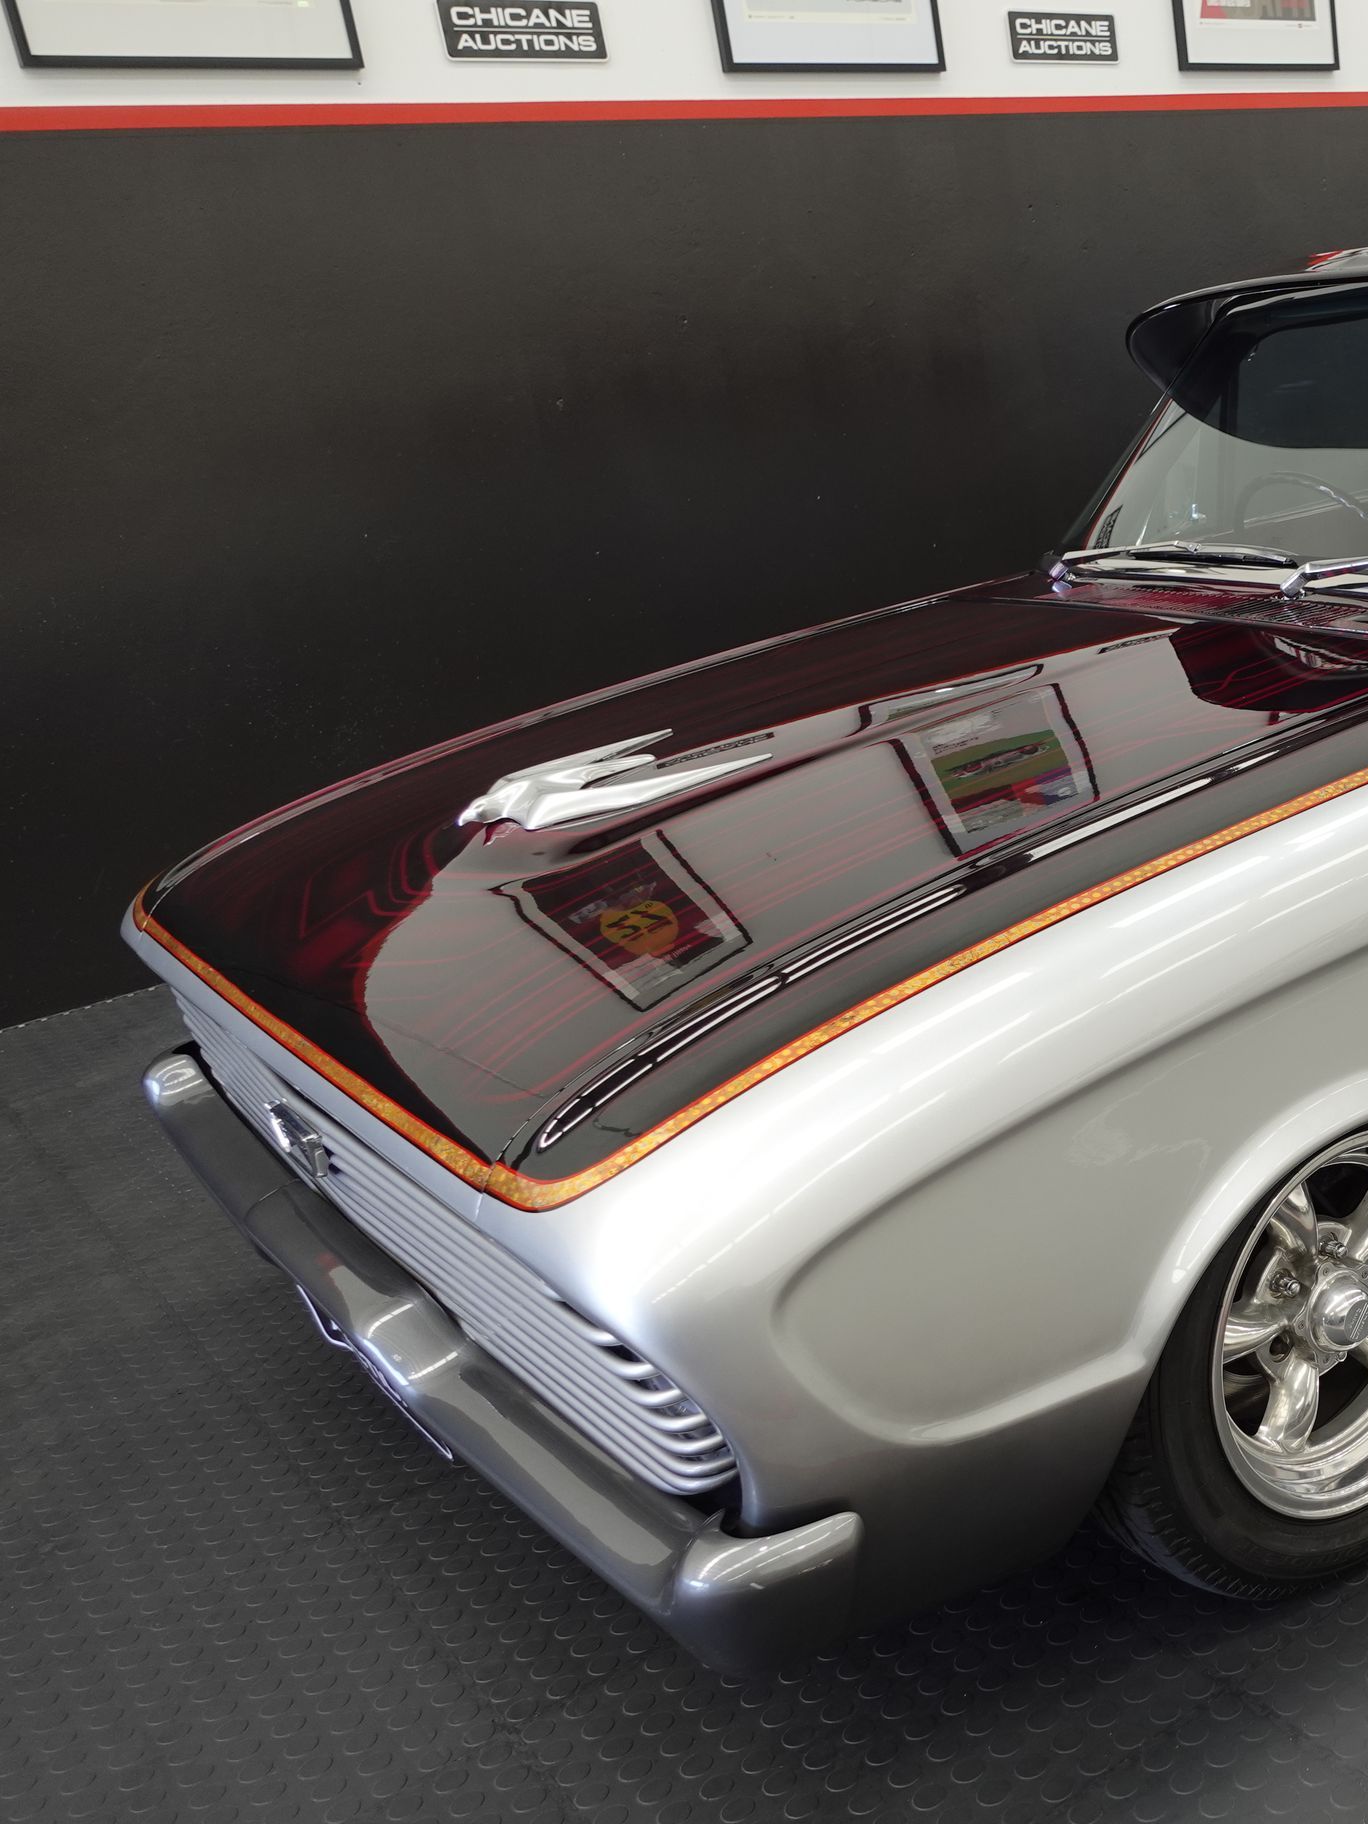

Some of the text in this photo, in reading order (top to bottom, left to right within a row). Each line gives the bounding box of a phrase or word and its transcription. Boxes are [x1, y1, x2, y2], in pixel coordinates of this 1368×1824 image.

[450, 6, 593, 28] CHICANE
[1015, 18, 1111, 36] CHICANE
[457, 33, 597, 51] AUCTIONS
[1018, 40, 1113, 56] AUCTIONS
